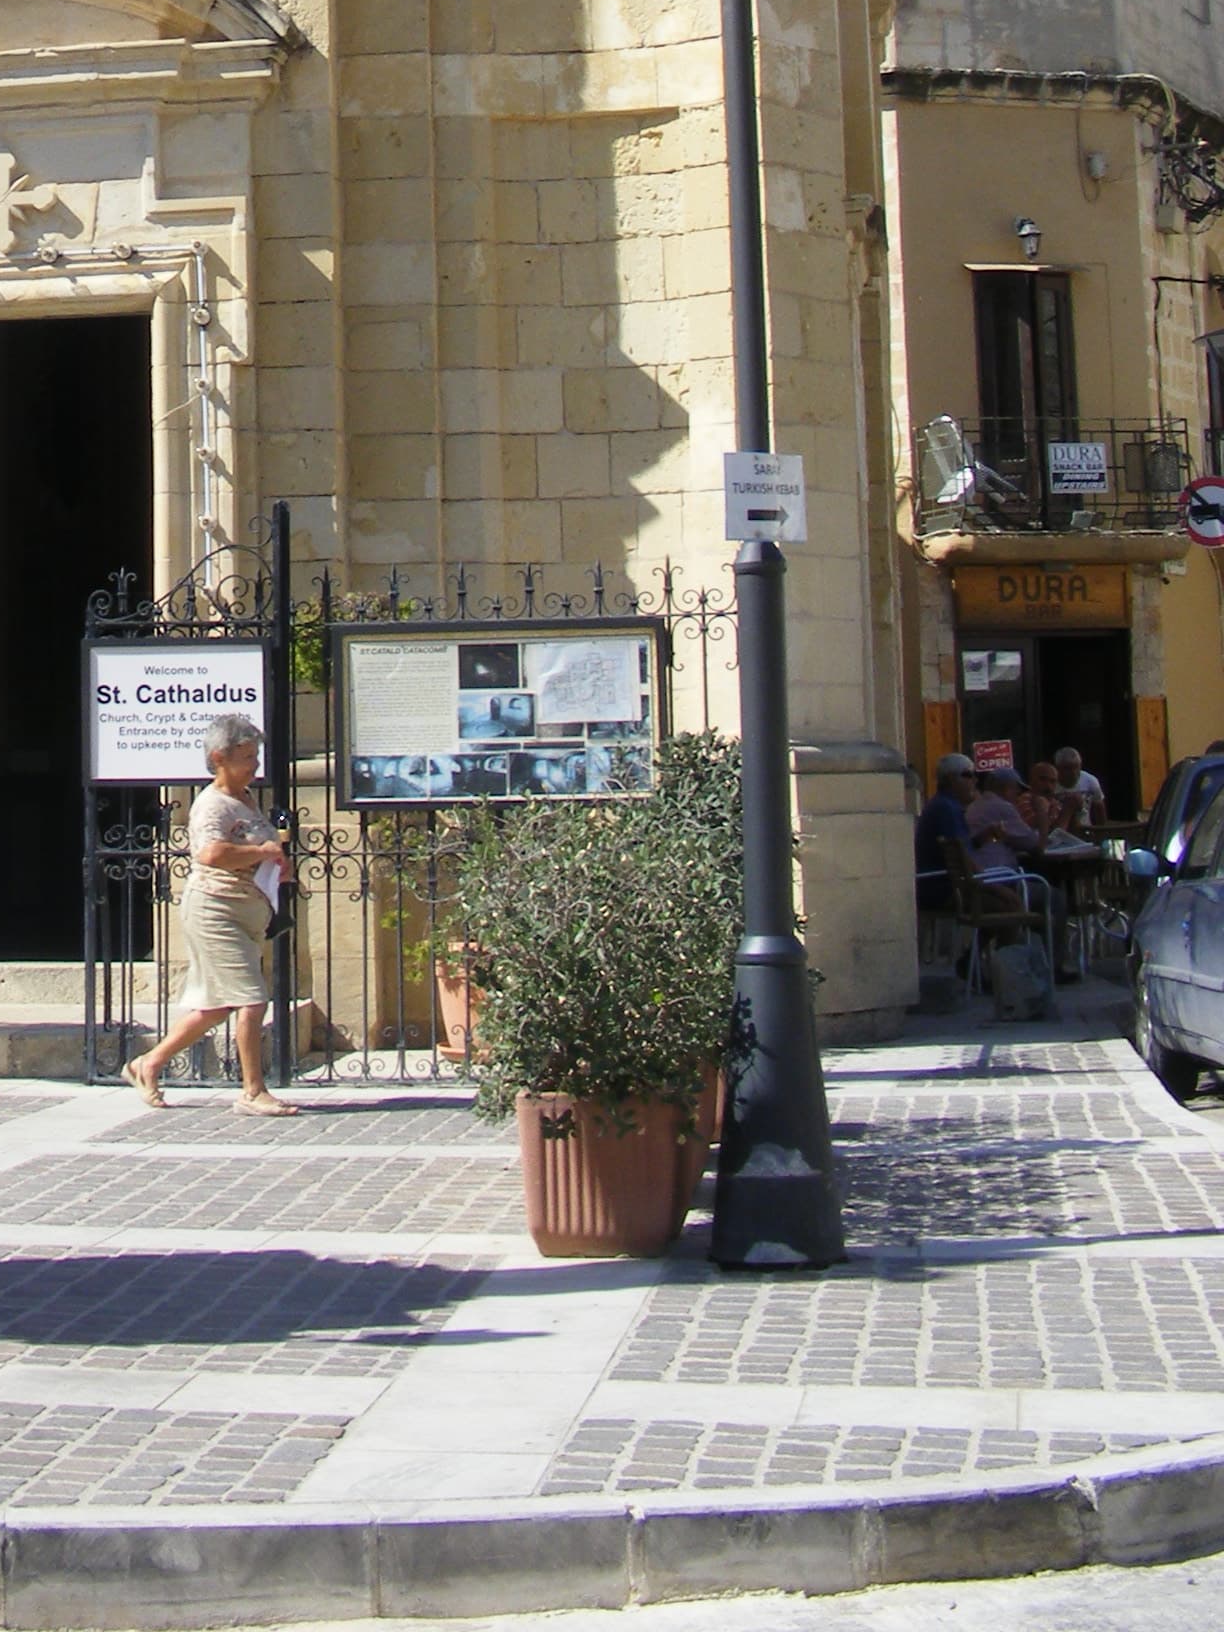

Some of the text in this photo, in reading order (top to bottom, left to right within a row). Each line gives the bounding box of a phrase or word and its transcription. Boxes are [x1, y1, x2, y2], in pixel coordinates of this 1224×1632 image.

[1053, 447, 1102, 461] DURA
[732, 481, 801, 496] TURKISH KEBAB
[998, 575, 1089, 603] DURA
[1025, 604, 1062, 619] BAR
[144, 666, 208, 675] Welcome to
[97, 683, 257, 704] St. Cathaldus
[99, 713, 142, 724] Church,
[145, 713, 176, 724] Crypt
[179, 713, 186, 721] &
[119, 727, 167, 736] Entrance
[170, 726, 183, 737] by
[117, 741, 127, 749] to
[131, 741, 170, 751] upkeep
[174, 740, 191, 749] the
[979, 758, 1010, 768] OPEN
